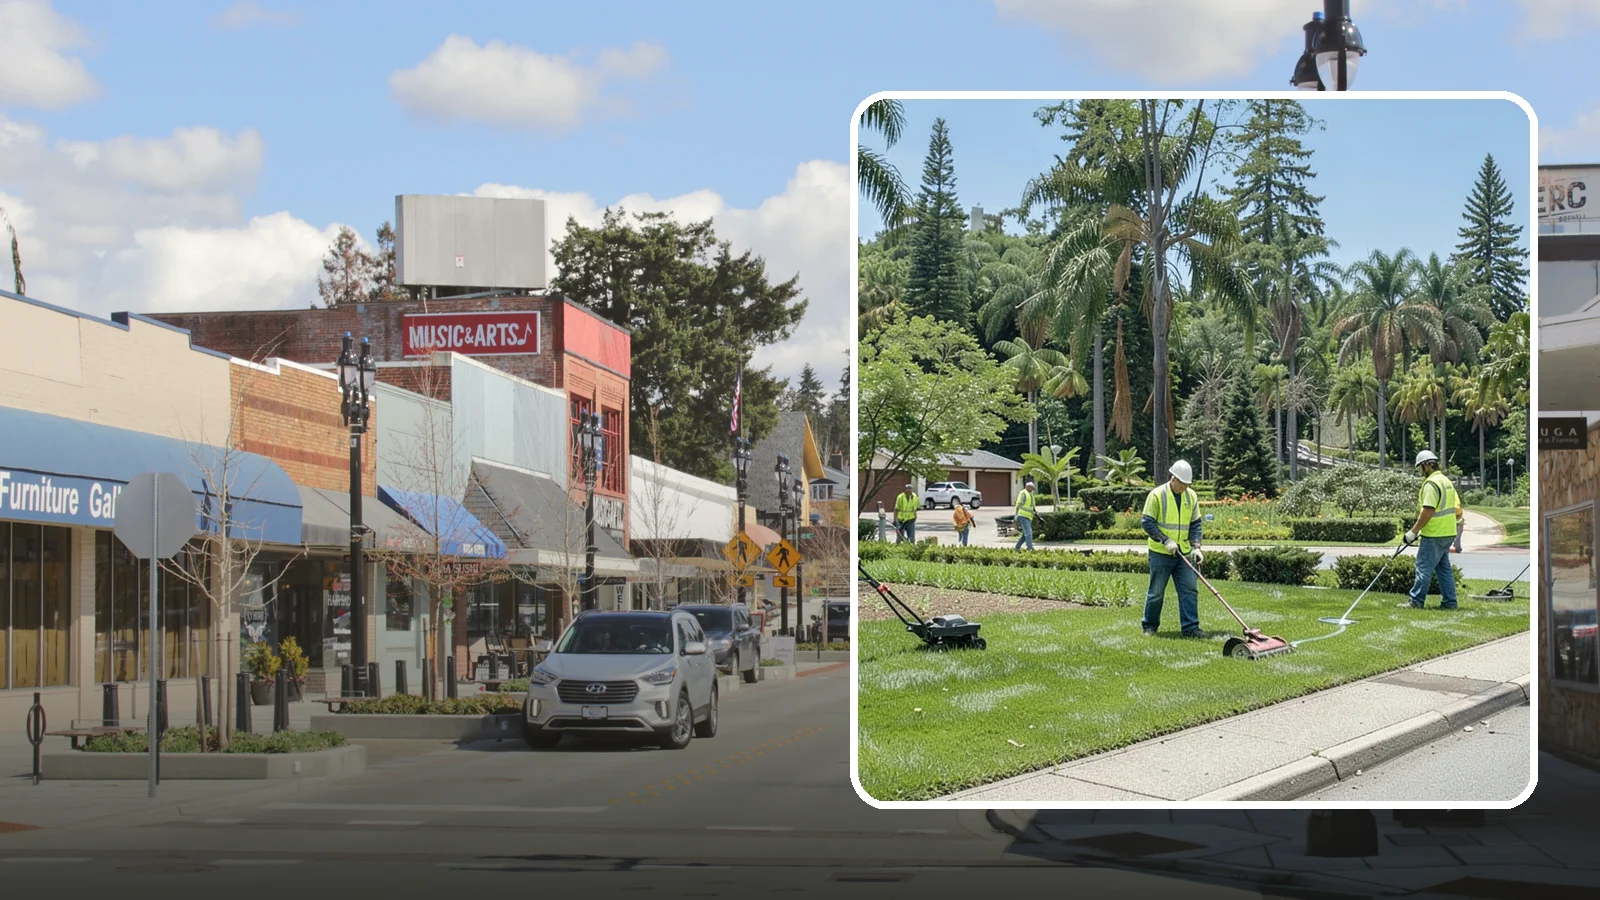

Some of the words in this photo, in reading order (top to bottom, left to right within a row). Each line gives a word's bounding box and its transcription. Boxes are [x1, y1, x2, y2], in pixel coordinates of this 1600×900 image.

[1540, 427, 1577, 437] UGA
[0, 471, 79, 515] Furniture
[89, 482, 121, 519] Gal
[453, 563, 479, 575] SUSHI
